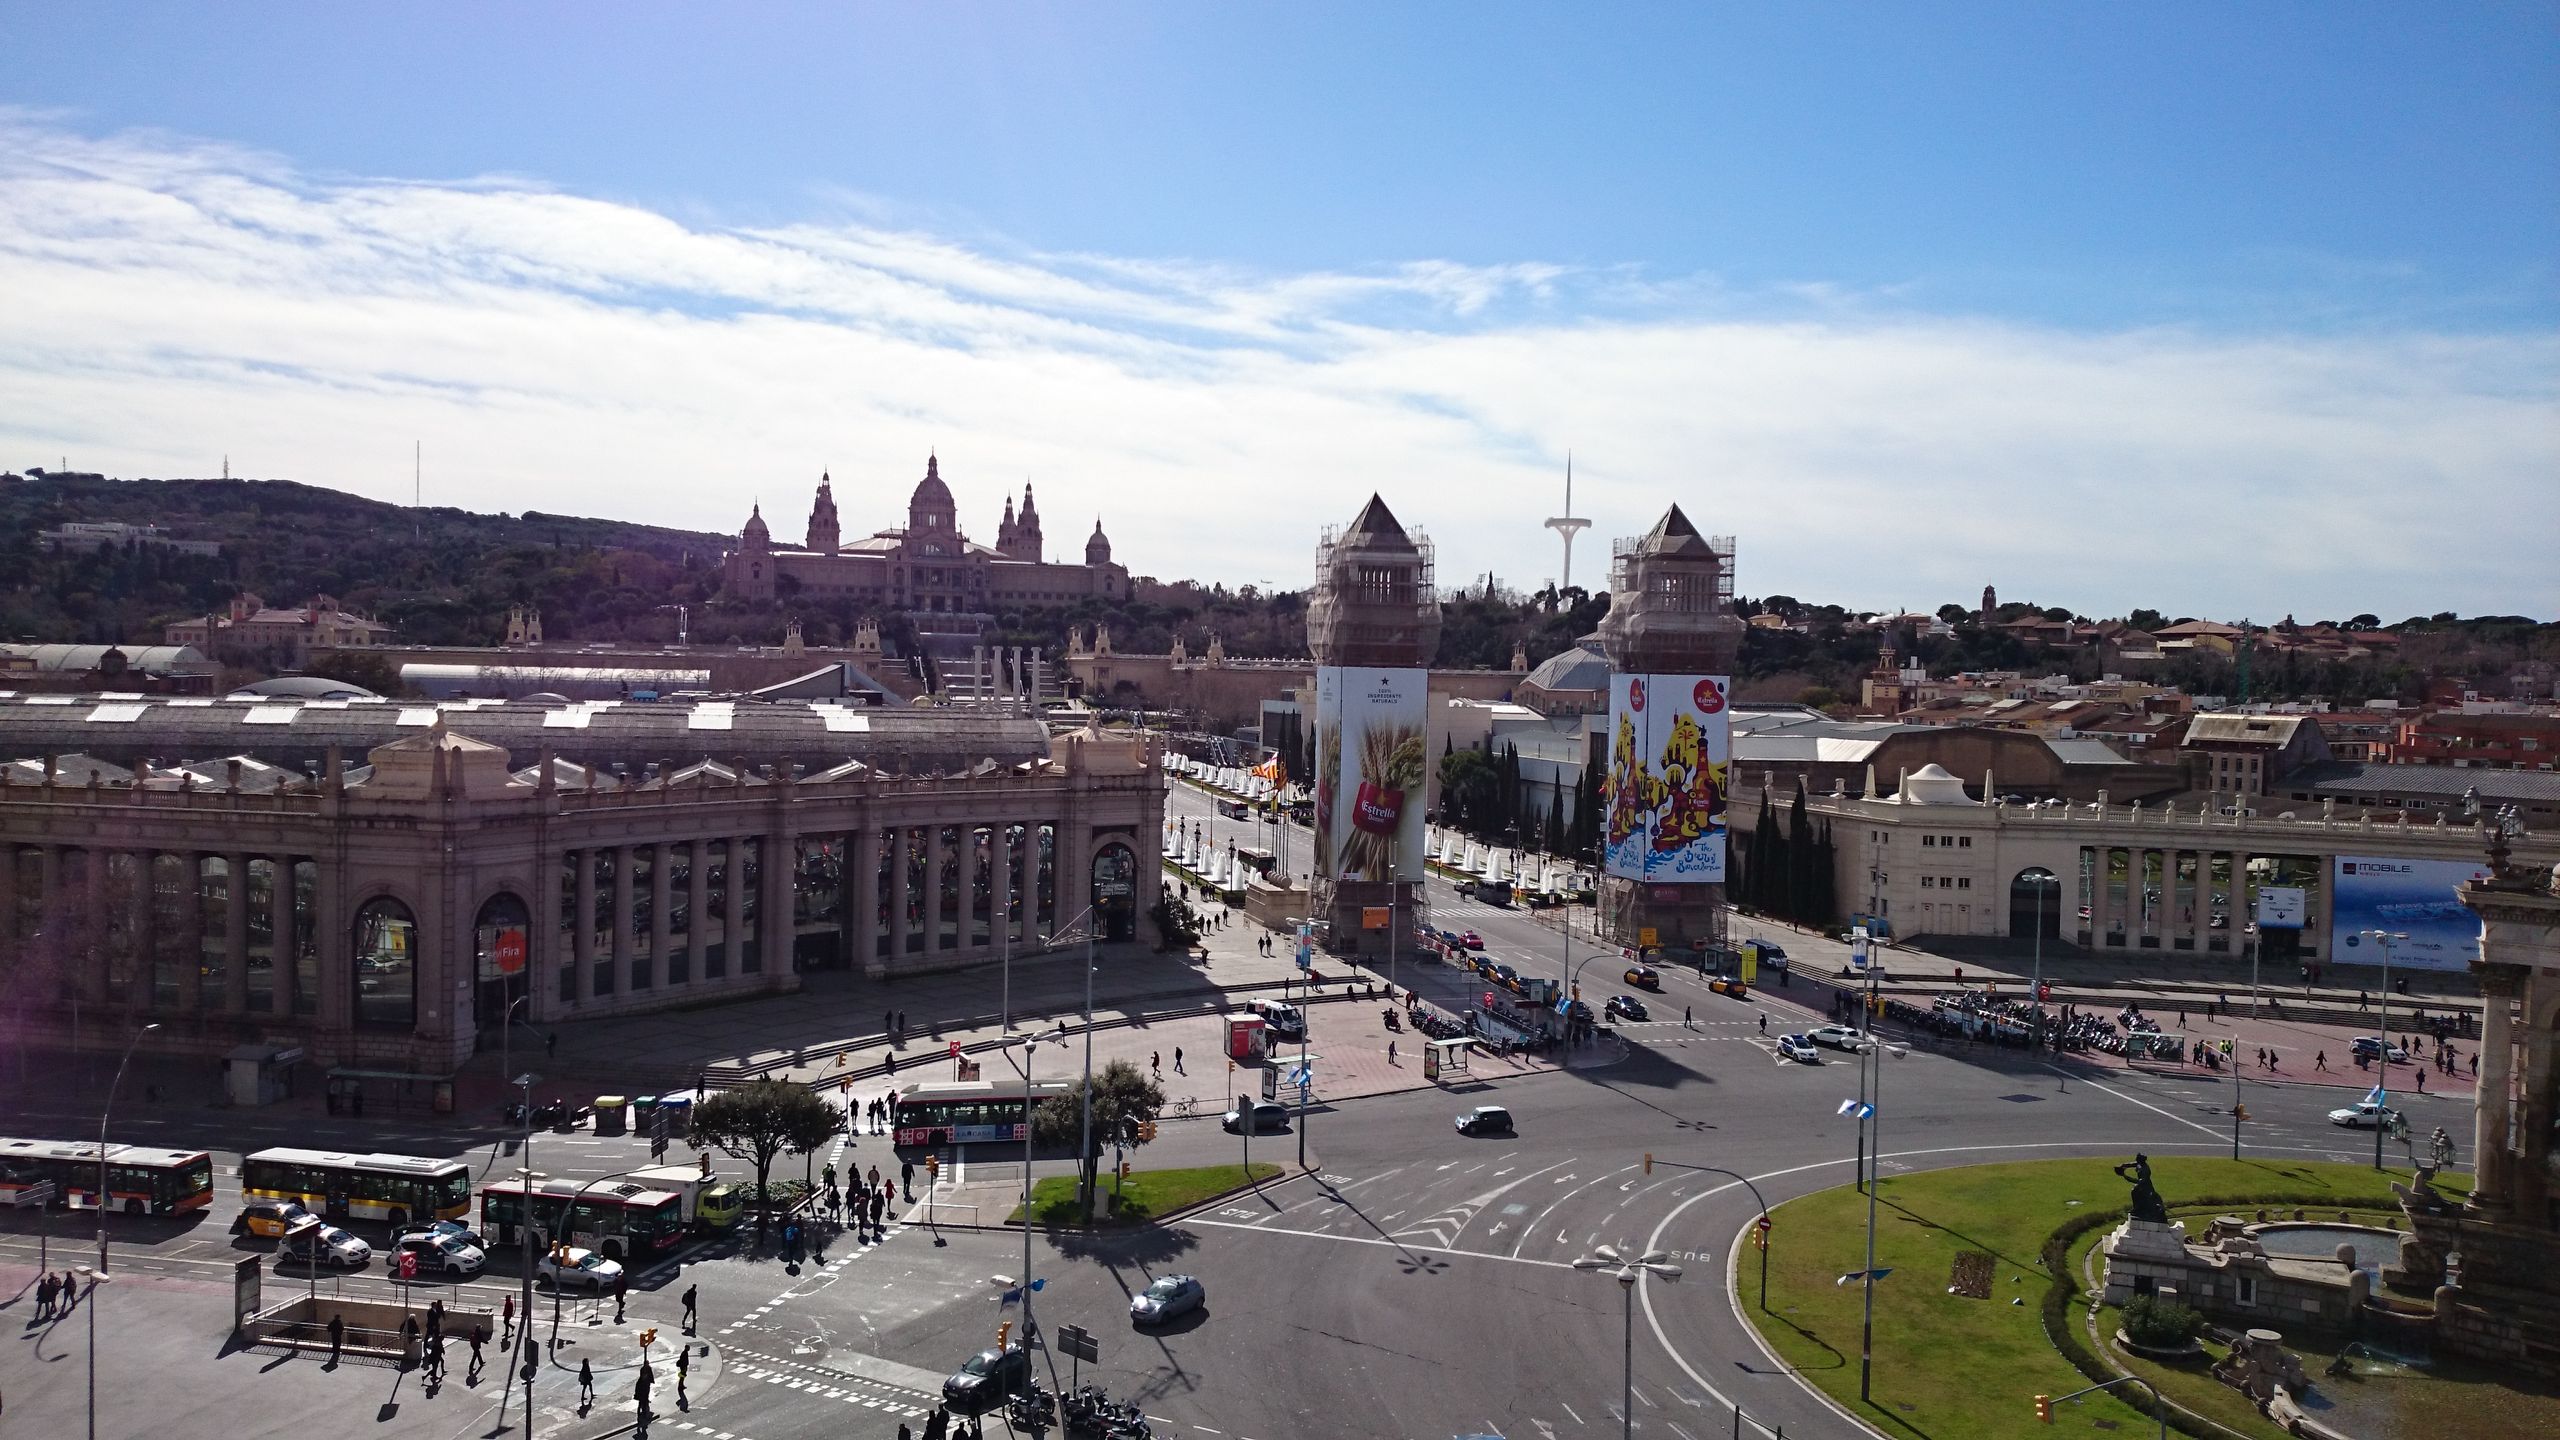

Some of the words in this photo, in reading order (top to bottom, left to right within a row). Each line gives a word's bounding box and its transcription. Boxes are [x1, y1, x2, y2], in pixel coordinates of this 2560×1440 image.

[1361, 800, 1395, 819] Estrella
[2359, 863, 2411, 873] MOBILE
[1219, 1208, 1259, 1219] BUS
[1670, 1250, 1711, 1262] BUS
